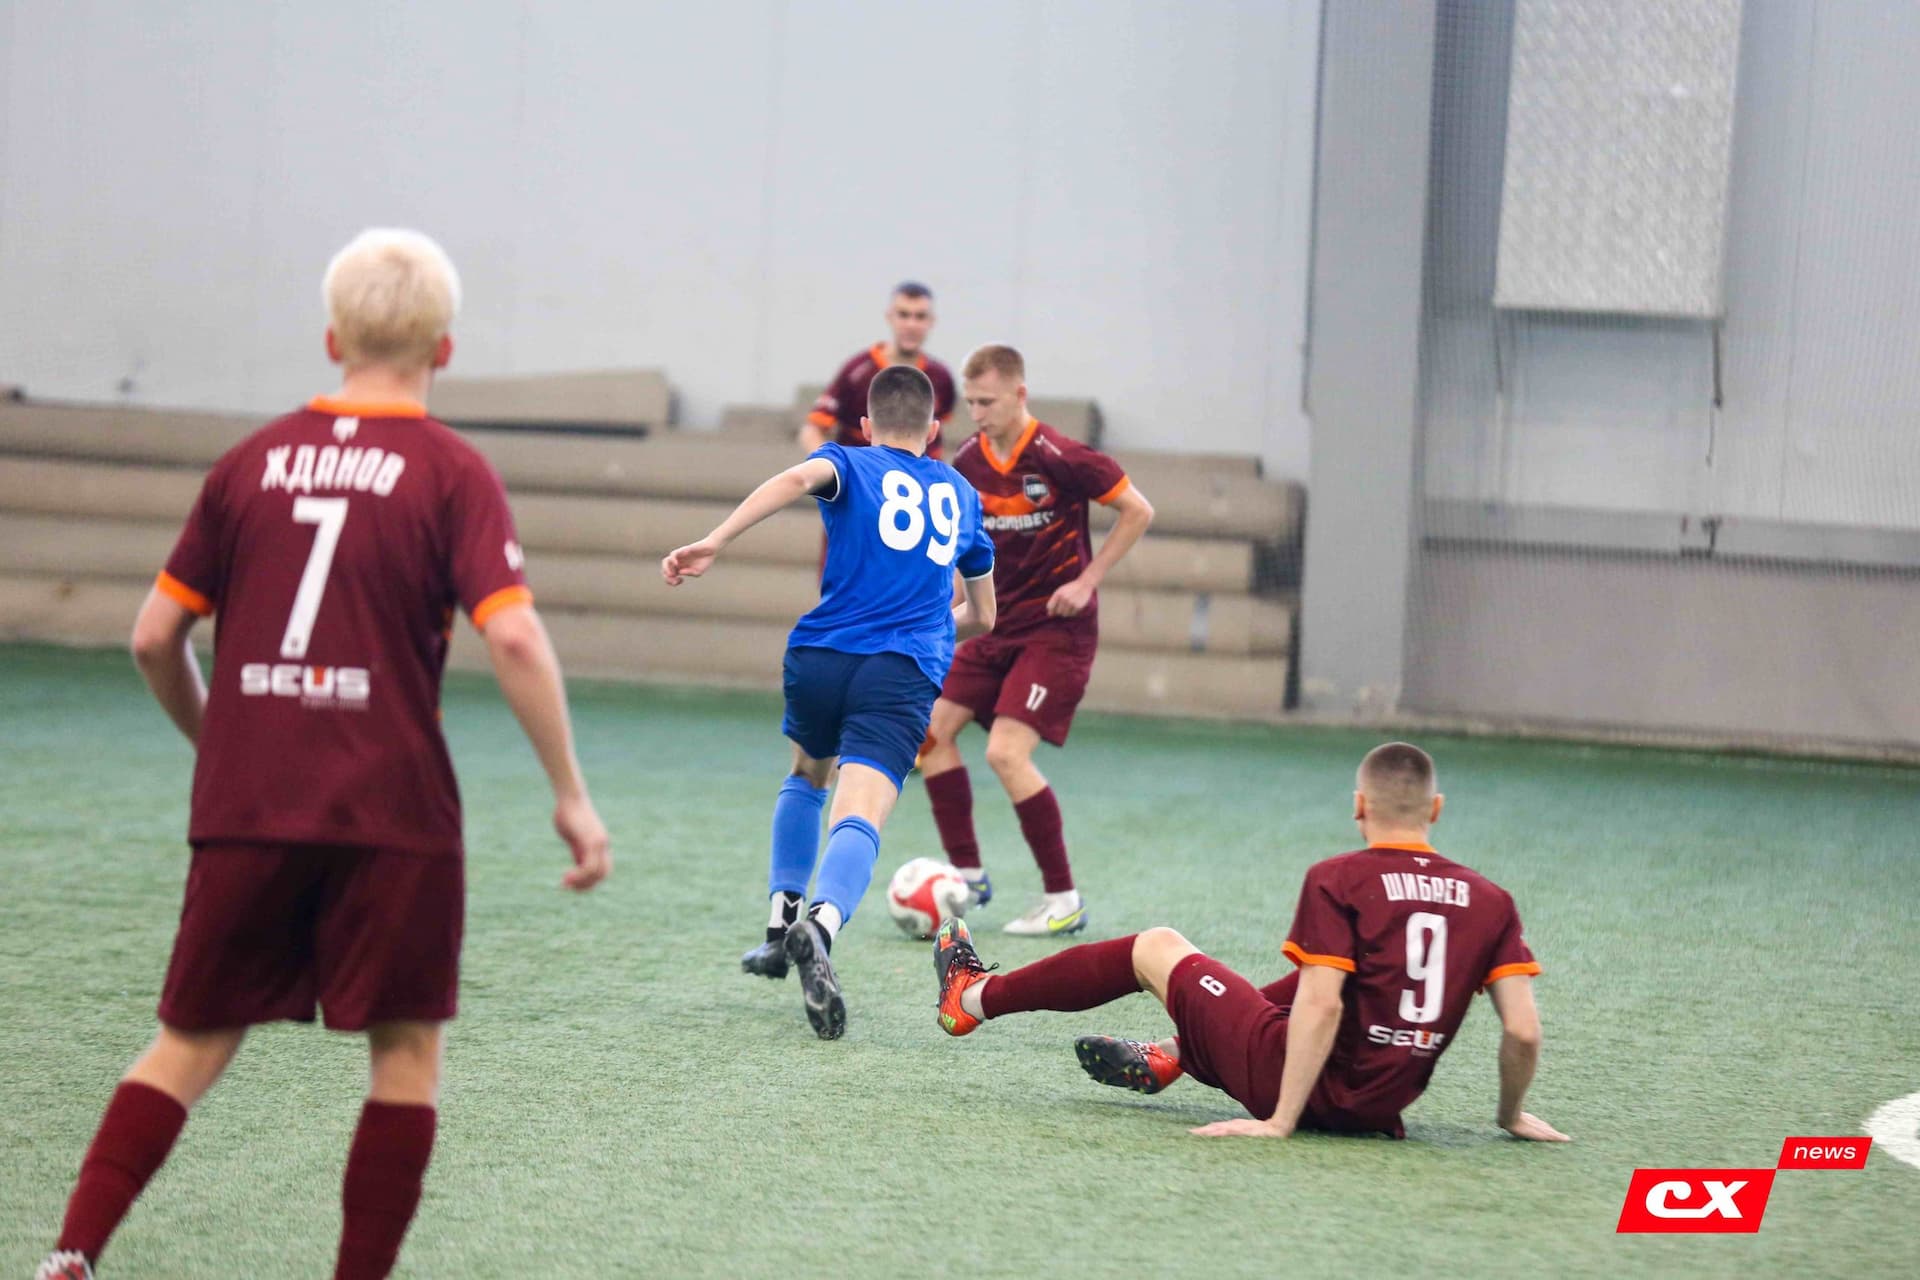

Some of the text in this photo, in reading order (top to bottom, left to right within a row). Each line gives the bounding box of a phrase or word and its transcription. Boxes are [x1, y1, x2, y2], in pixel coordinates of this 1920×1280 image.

[261, 444, 405, 497] ЖДАНОВ
[878, 469, 960, 567] 89
[280, 497, 348, 659] 7
[240, 663, 370, 697] SEUS
[1026, 683, 1047, 711] 17
[1380, 872, 1471, 908] ШИБАЕВ
[1399, 912, 1447, 1023] 9
